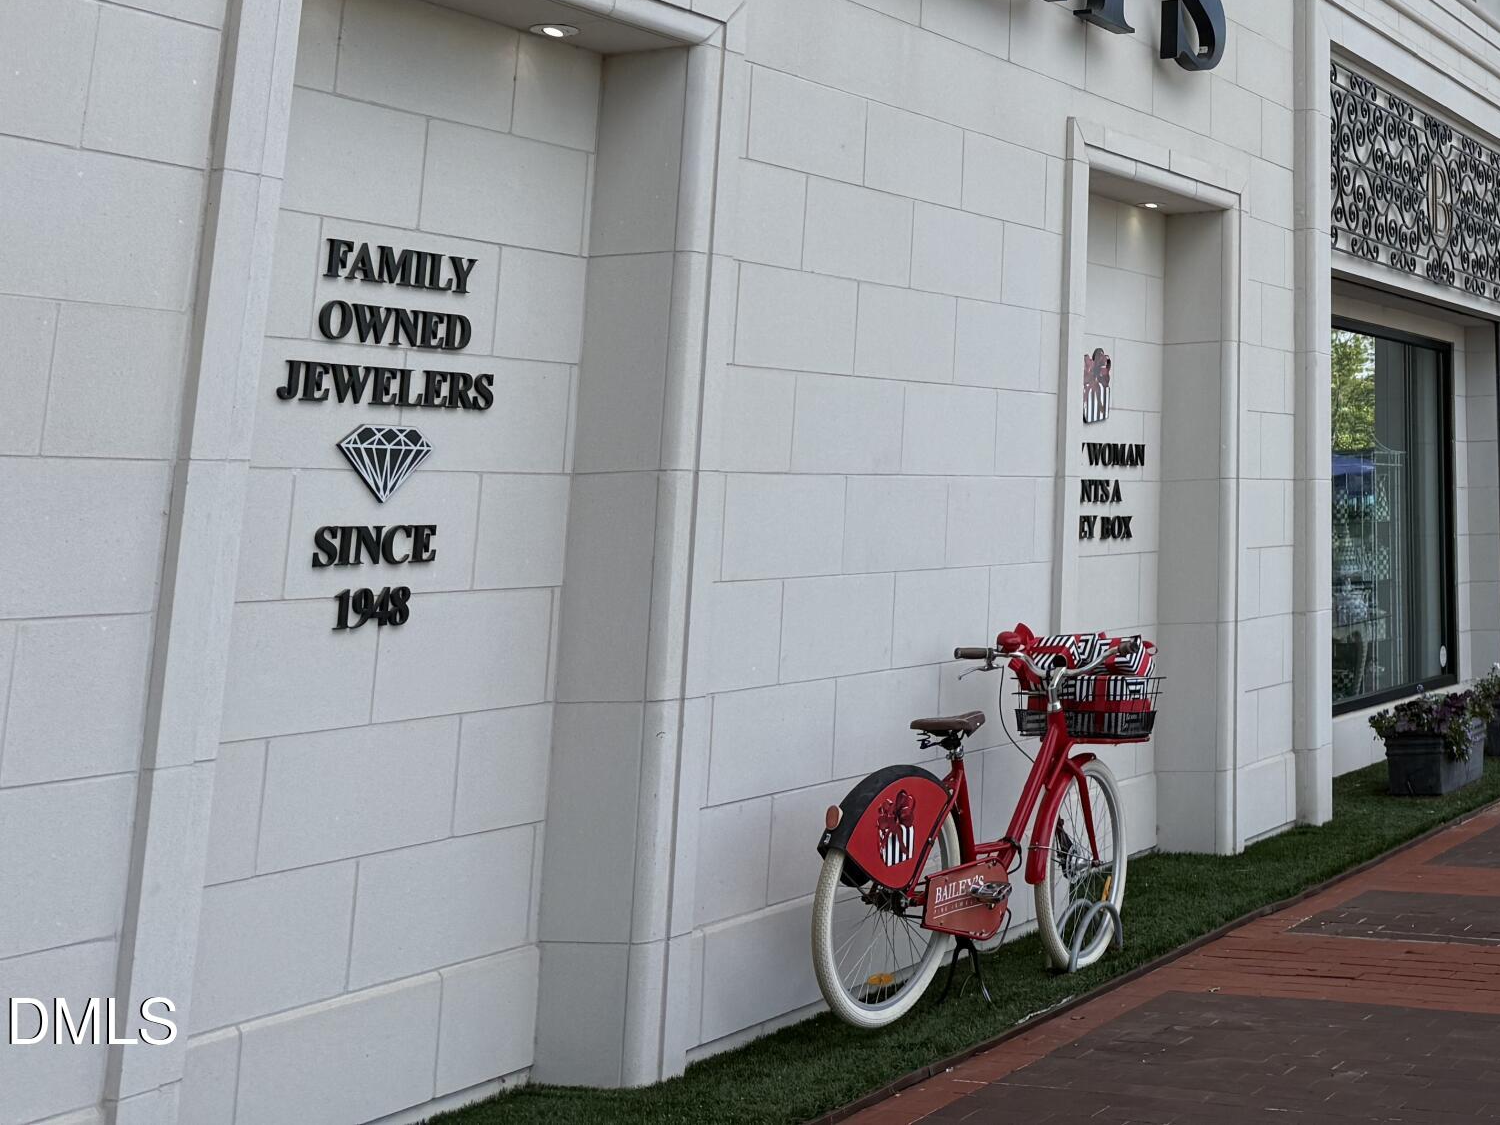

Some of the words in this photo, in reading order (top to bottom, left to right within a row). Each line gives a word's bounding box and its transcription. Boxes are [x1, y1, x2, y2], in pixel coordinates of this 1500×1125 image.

[323, 238, 478, 293] FAMILY
[319, 300, 472, 351] OWNED
[276, 359, 495, 411] JEWELERS
[1087, 442, 1146, 467] WOMAN
[1080, 479, 1110, 503] NTS
[1110, 479, 1122, 503] A
[312, 524, 437, 568] SINCE
[1099, 515, 1133, 540] BOX
[332, 586, 411, 630] 1948
[935, 874, 984, 904] BAILEY'S
